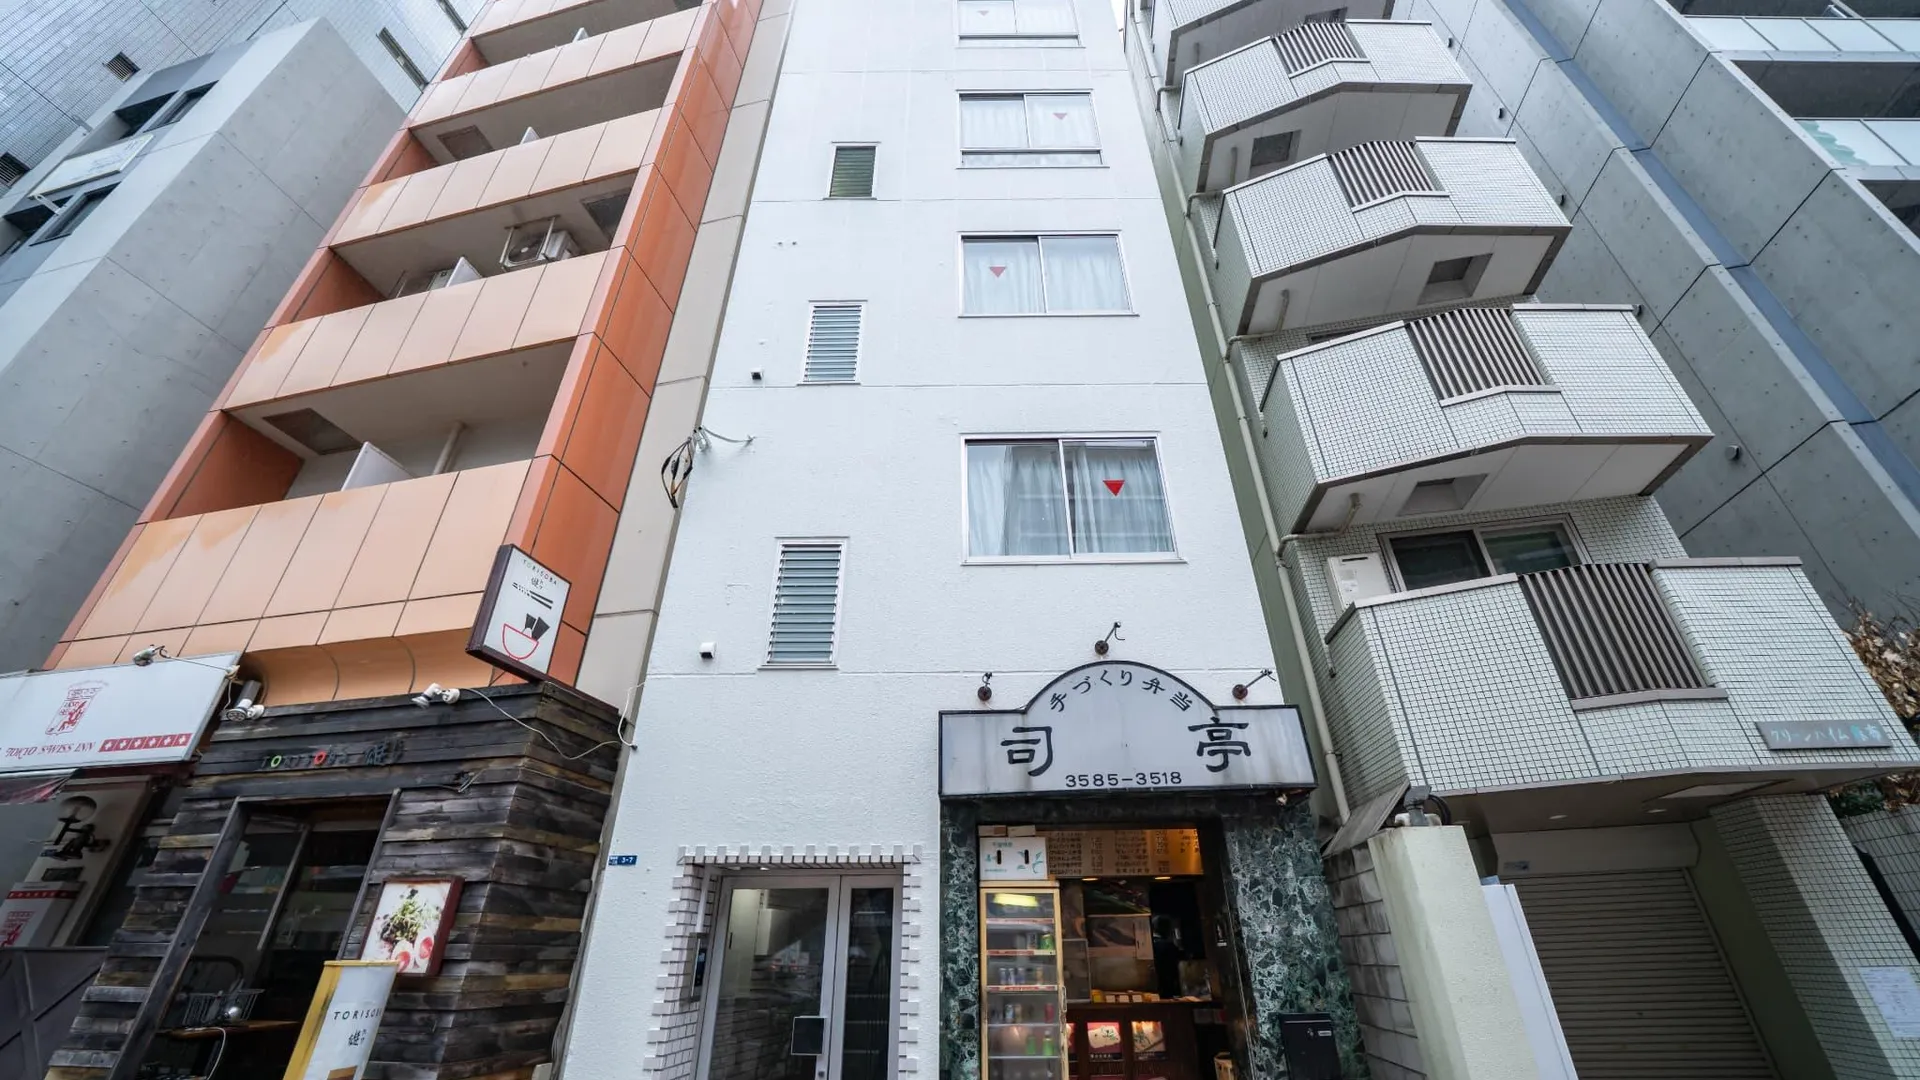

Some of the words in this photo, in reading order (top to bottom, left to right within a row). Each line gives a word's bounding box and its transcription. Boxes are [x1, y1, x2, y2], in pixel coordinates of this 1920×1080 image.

[1050, 669, 1193, 713] 手づくり弁当
[1065, 771, 1182, 788] 3585-3518
